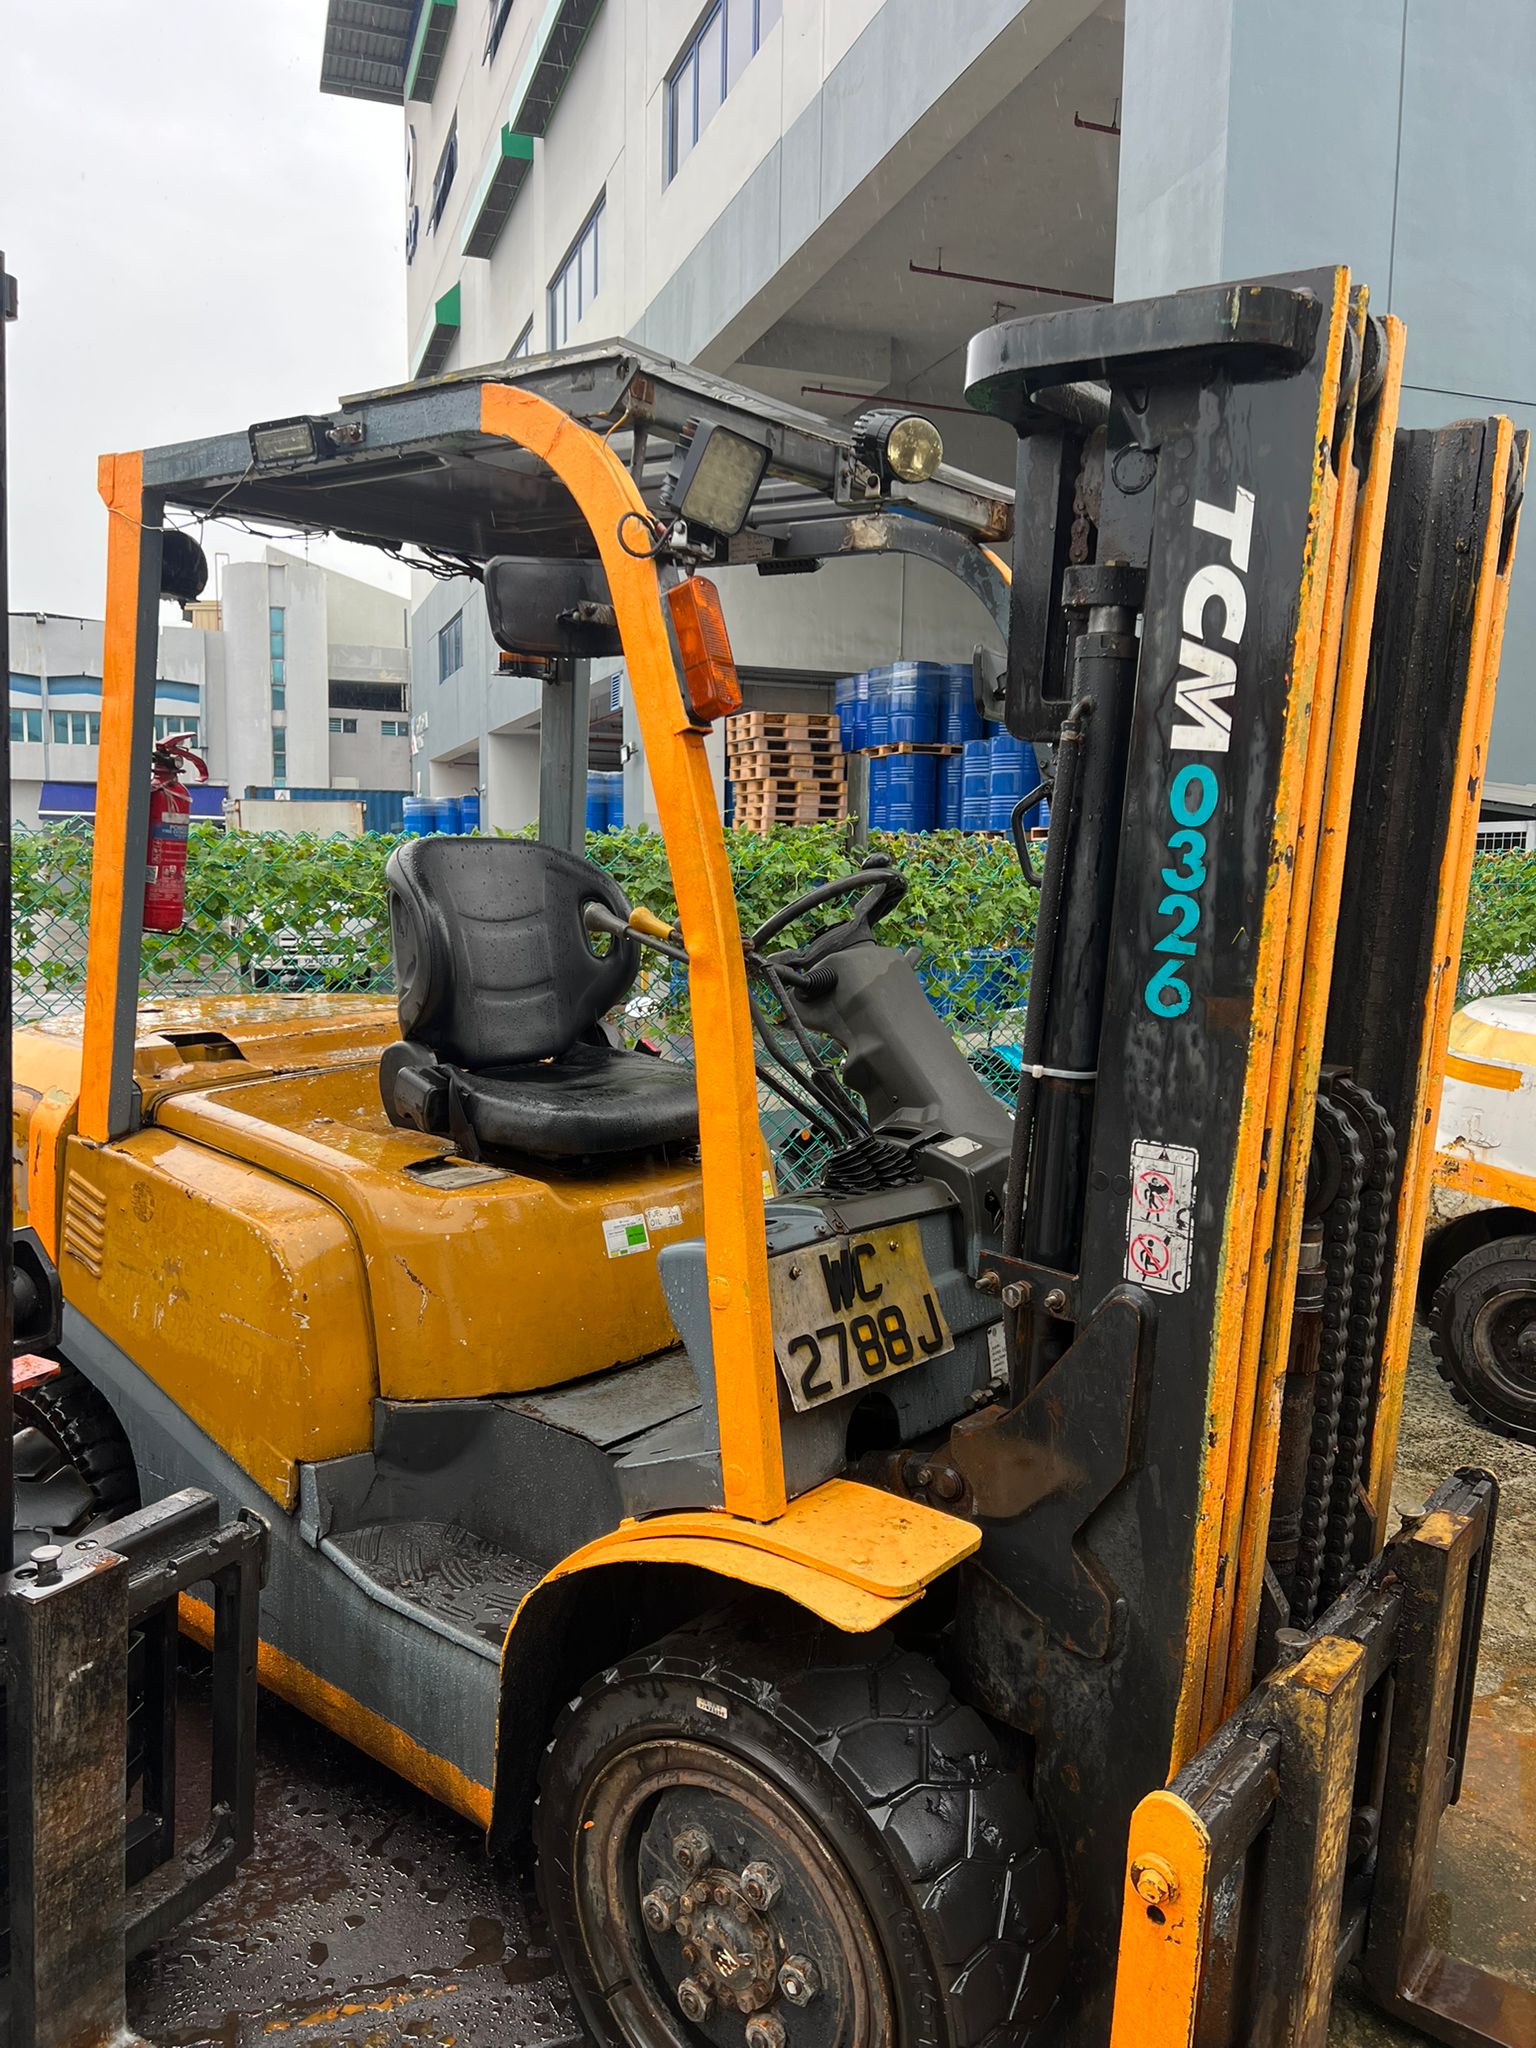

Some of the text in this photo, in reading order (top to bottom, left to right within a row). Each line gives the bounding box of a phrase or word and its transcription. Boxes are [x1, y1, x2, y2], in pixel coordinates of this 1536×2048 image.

[1170, 485, 1255, 752] TCM
[1145, 763, 1219, 1018] 0326
[819, 1243, 883, 1313] WC
